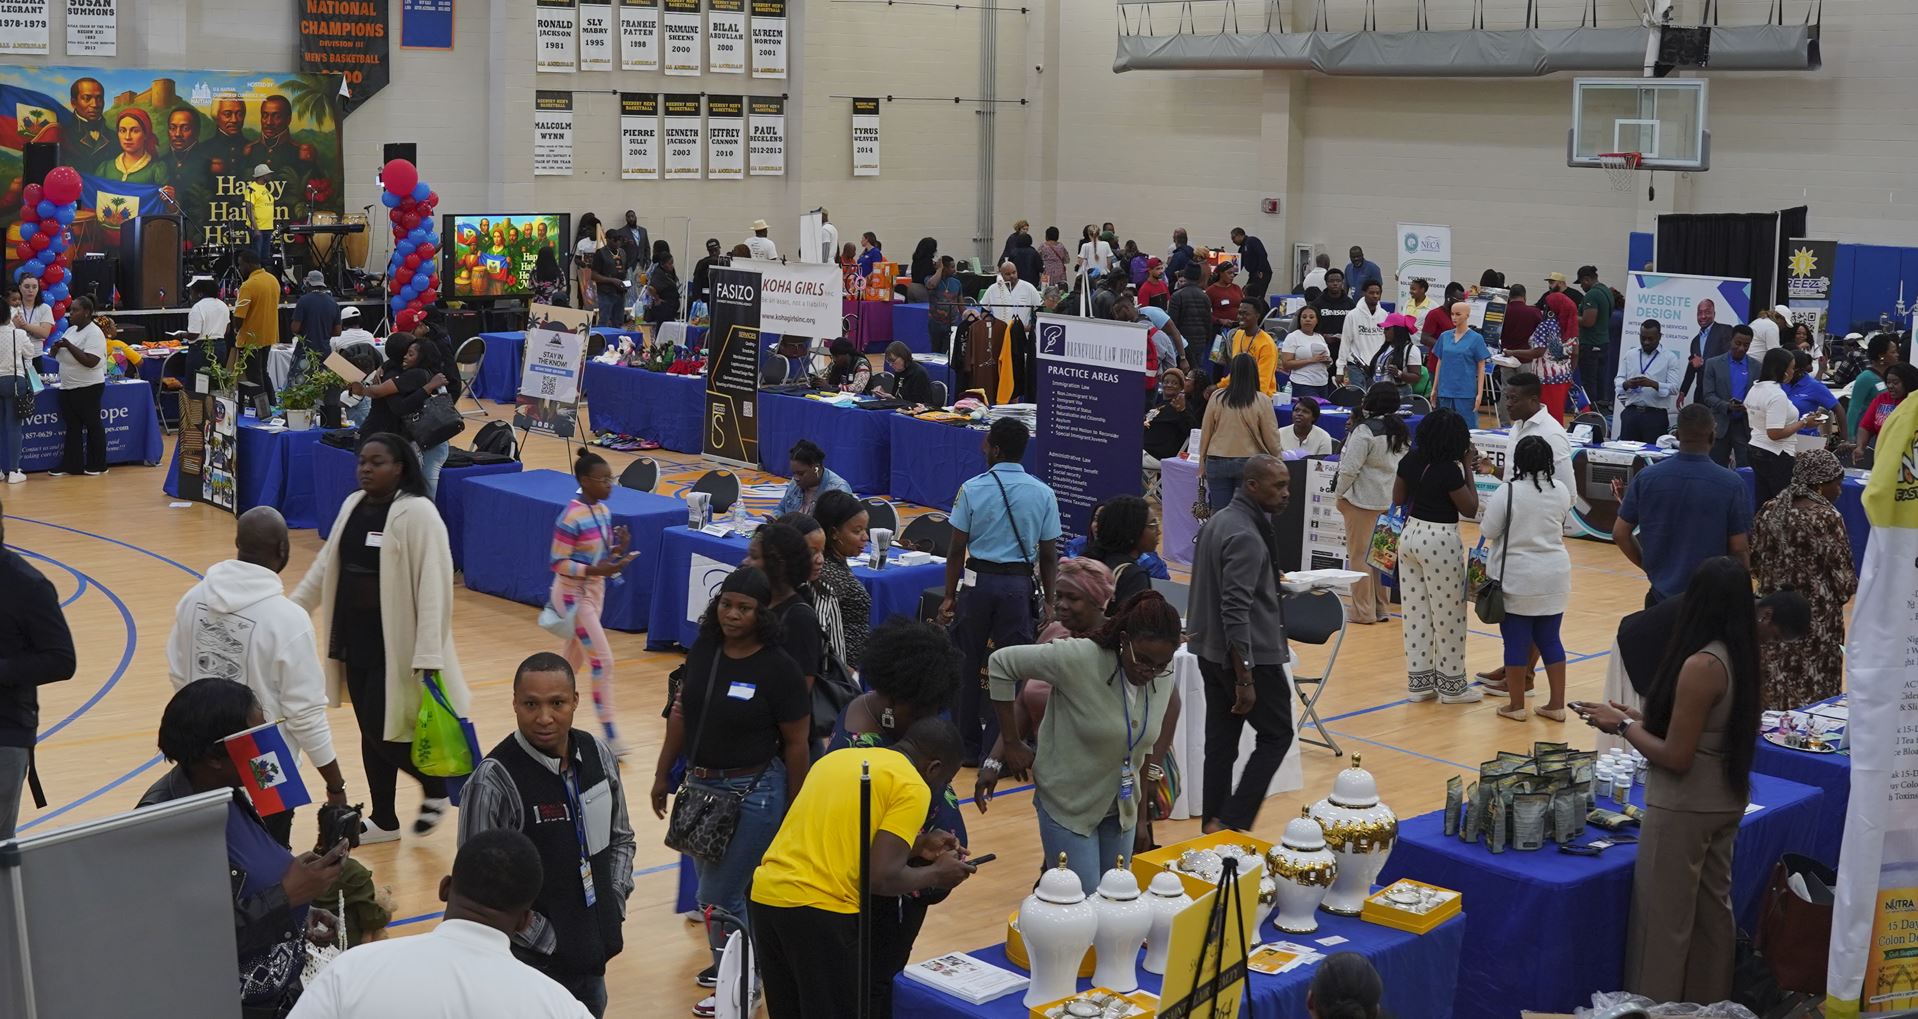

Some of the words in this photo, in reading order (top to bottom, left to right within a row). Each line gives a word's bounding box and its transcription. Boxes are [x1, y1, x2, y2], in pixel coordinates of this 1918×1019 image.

[1, 6, 43, 14] LEGRANT
[67, 8, 115, 16] SUMMONS
[307, 1, 376, 16] NATIONAL
[538, 19, 573, 28] RONALD
[621, 20, 656, 28] FRANKIE
[713, 23, 739, 32] BILAL
[301, 21, 384, 37] CHAMPIONS
[665, 25, 699, 33] TRAMAINE
[319, 40, 353, 48] DIVISION
[305, 53, 327, 63] MEN'S
[329, 54, 380, 63] BASKETBALL
[535, 122, 572, 130] MALCOLM
[754, 126, 778, 135] PAUL
[623, 129, 655, 137] PIERRE
[666, 129, 699, 137] KENNETH
[709, 128, 740, 138] JEFFREY
[1421, 240, 1440, 249] NECA
[716, 283, 754, 301] FASIZO
[761, 279, 792, 293] KOHA
[795, 281, 825, 296] GIRLS
[1638, 294, 1691, 307] WEBSITE
[1636, 307, 1681, 320] DESIGN
[762, 313, 815, 325] www.kohagirlsinc.org
[543, 351, 557, 359] STAY
[538, 357, 549, 365] THE
[549, 359, 568, 368] KNOW!
[1048, 365, 1089, 379] PRACTICE
[1091, 371, 1119, 383] AREAS
[1052, 380, 1080, 388] Immigration
[100, 407, 129, 424] ope
[1048, 451, 1081, 461] Administrative
[1885, 899, 1914, 910] NUTRA
[1888, 921, 1898, 931] 15
[1879, 935, 1905, 947] Colon
